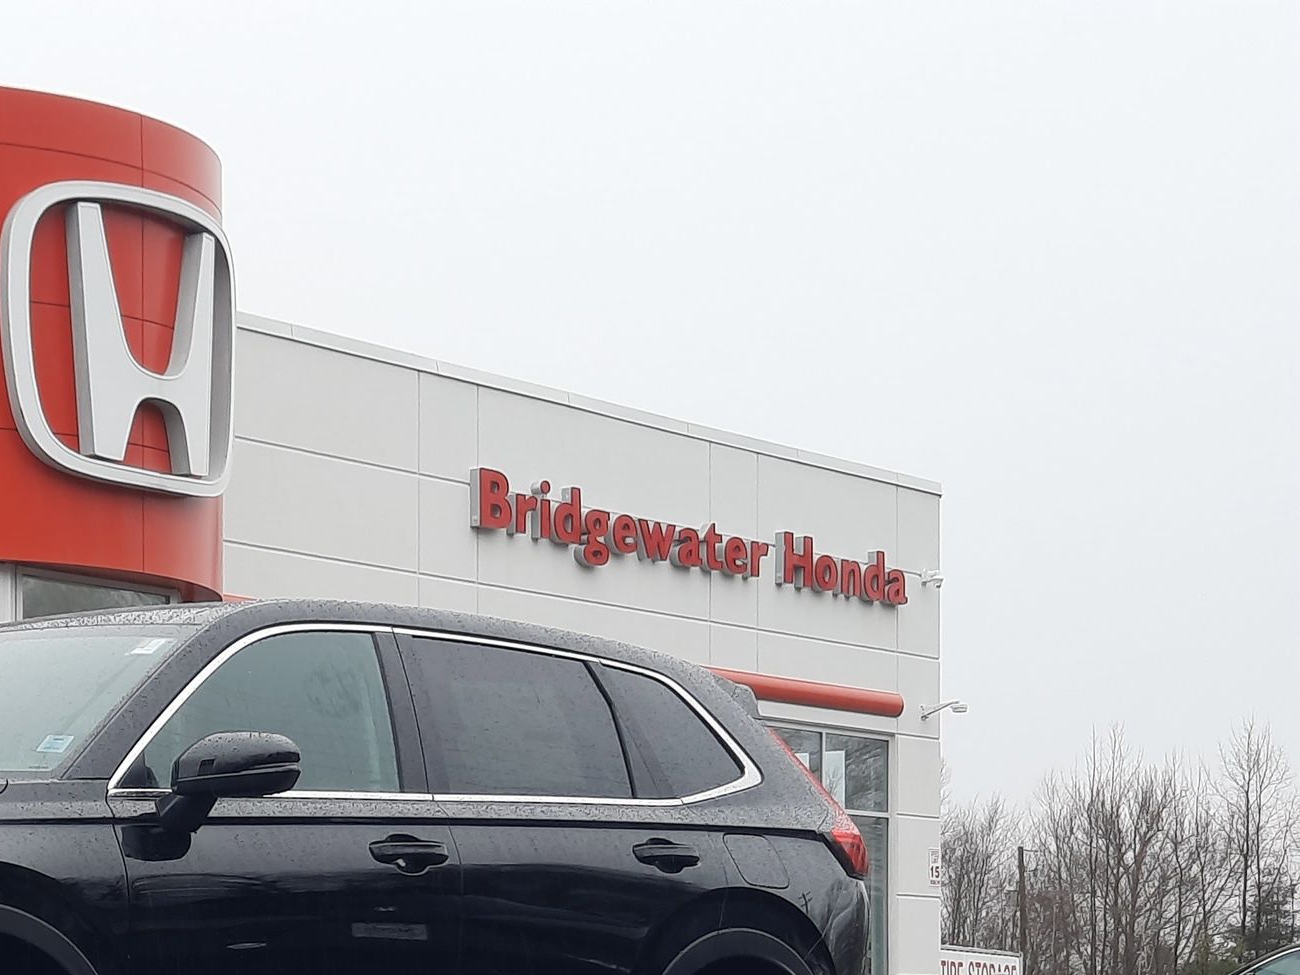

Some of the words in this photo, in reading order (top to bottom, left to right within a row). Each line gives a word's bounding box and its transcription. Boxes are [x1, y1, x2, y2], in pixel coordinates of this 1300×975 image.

[475, 466, 769, 579] Bridgewater
[779, 530, 908, 607] Honda
[930, 865, 940, 879] 15
